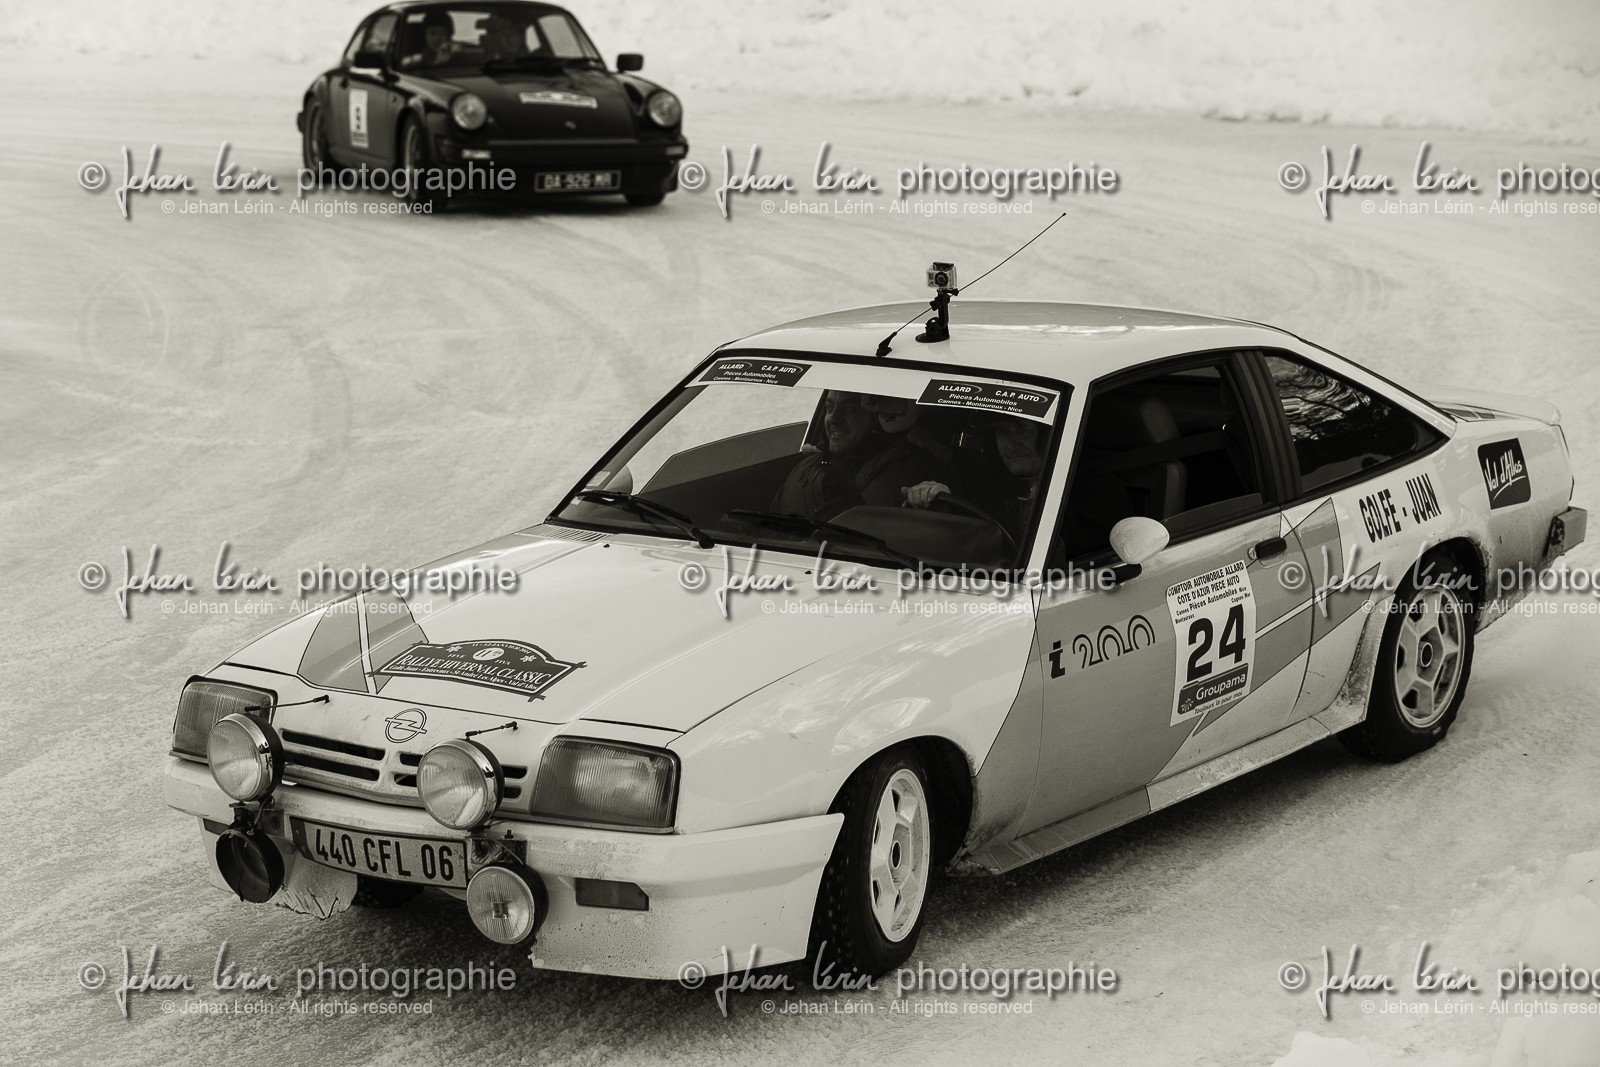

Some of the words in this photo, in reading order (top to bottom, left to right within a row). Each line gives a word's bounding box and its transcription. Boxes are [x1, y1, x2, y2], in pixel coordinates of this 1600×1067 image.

[966, 400, 1003, 410] Montauroux
[973, 396, 1018, 406] Automobiles
[1018, 393, 1040, 402] AUTO
[1484, 458, 1498, 492] Val
[1500, 449, 1522, 486] d'Allos
[1359, 488, 1402, 543] GOLFE
[1406, 472, 1442, 524] JUAN
[1168, 580, 1193, 597] COMPTOIR
[1194, 568, 1224, 588] AUTOMOBILE
[1224, 561, 1244, 576] ALLARD
[1176, 592, 1192, 605] COTE
[1192, 585, 1210, 598] D'AZUR
[1210, 580, 1226, 592] PIECE
[1226, 574, 1240, 587] AUTO
[1176, 608, 1190, 616] Cannes
[1189, 600, 1206, 610] Pièces
[1208, 588, 1238, 604] Automobiles
[1187, 604, 1246, 682] 24
[396, 654, 444, 668] RALLYE
[440, 659, 499, 675] HIVERNAL
[496, 668, 552, 684] CLASSIC
[1196, 673, 1246, 700] Groupama
[316, 829, 356, 868] 440
[363, 837, 412, 877] CFL
[420, 844, 454, 882] 06
